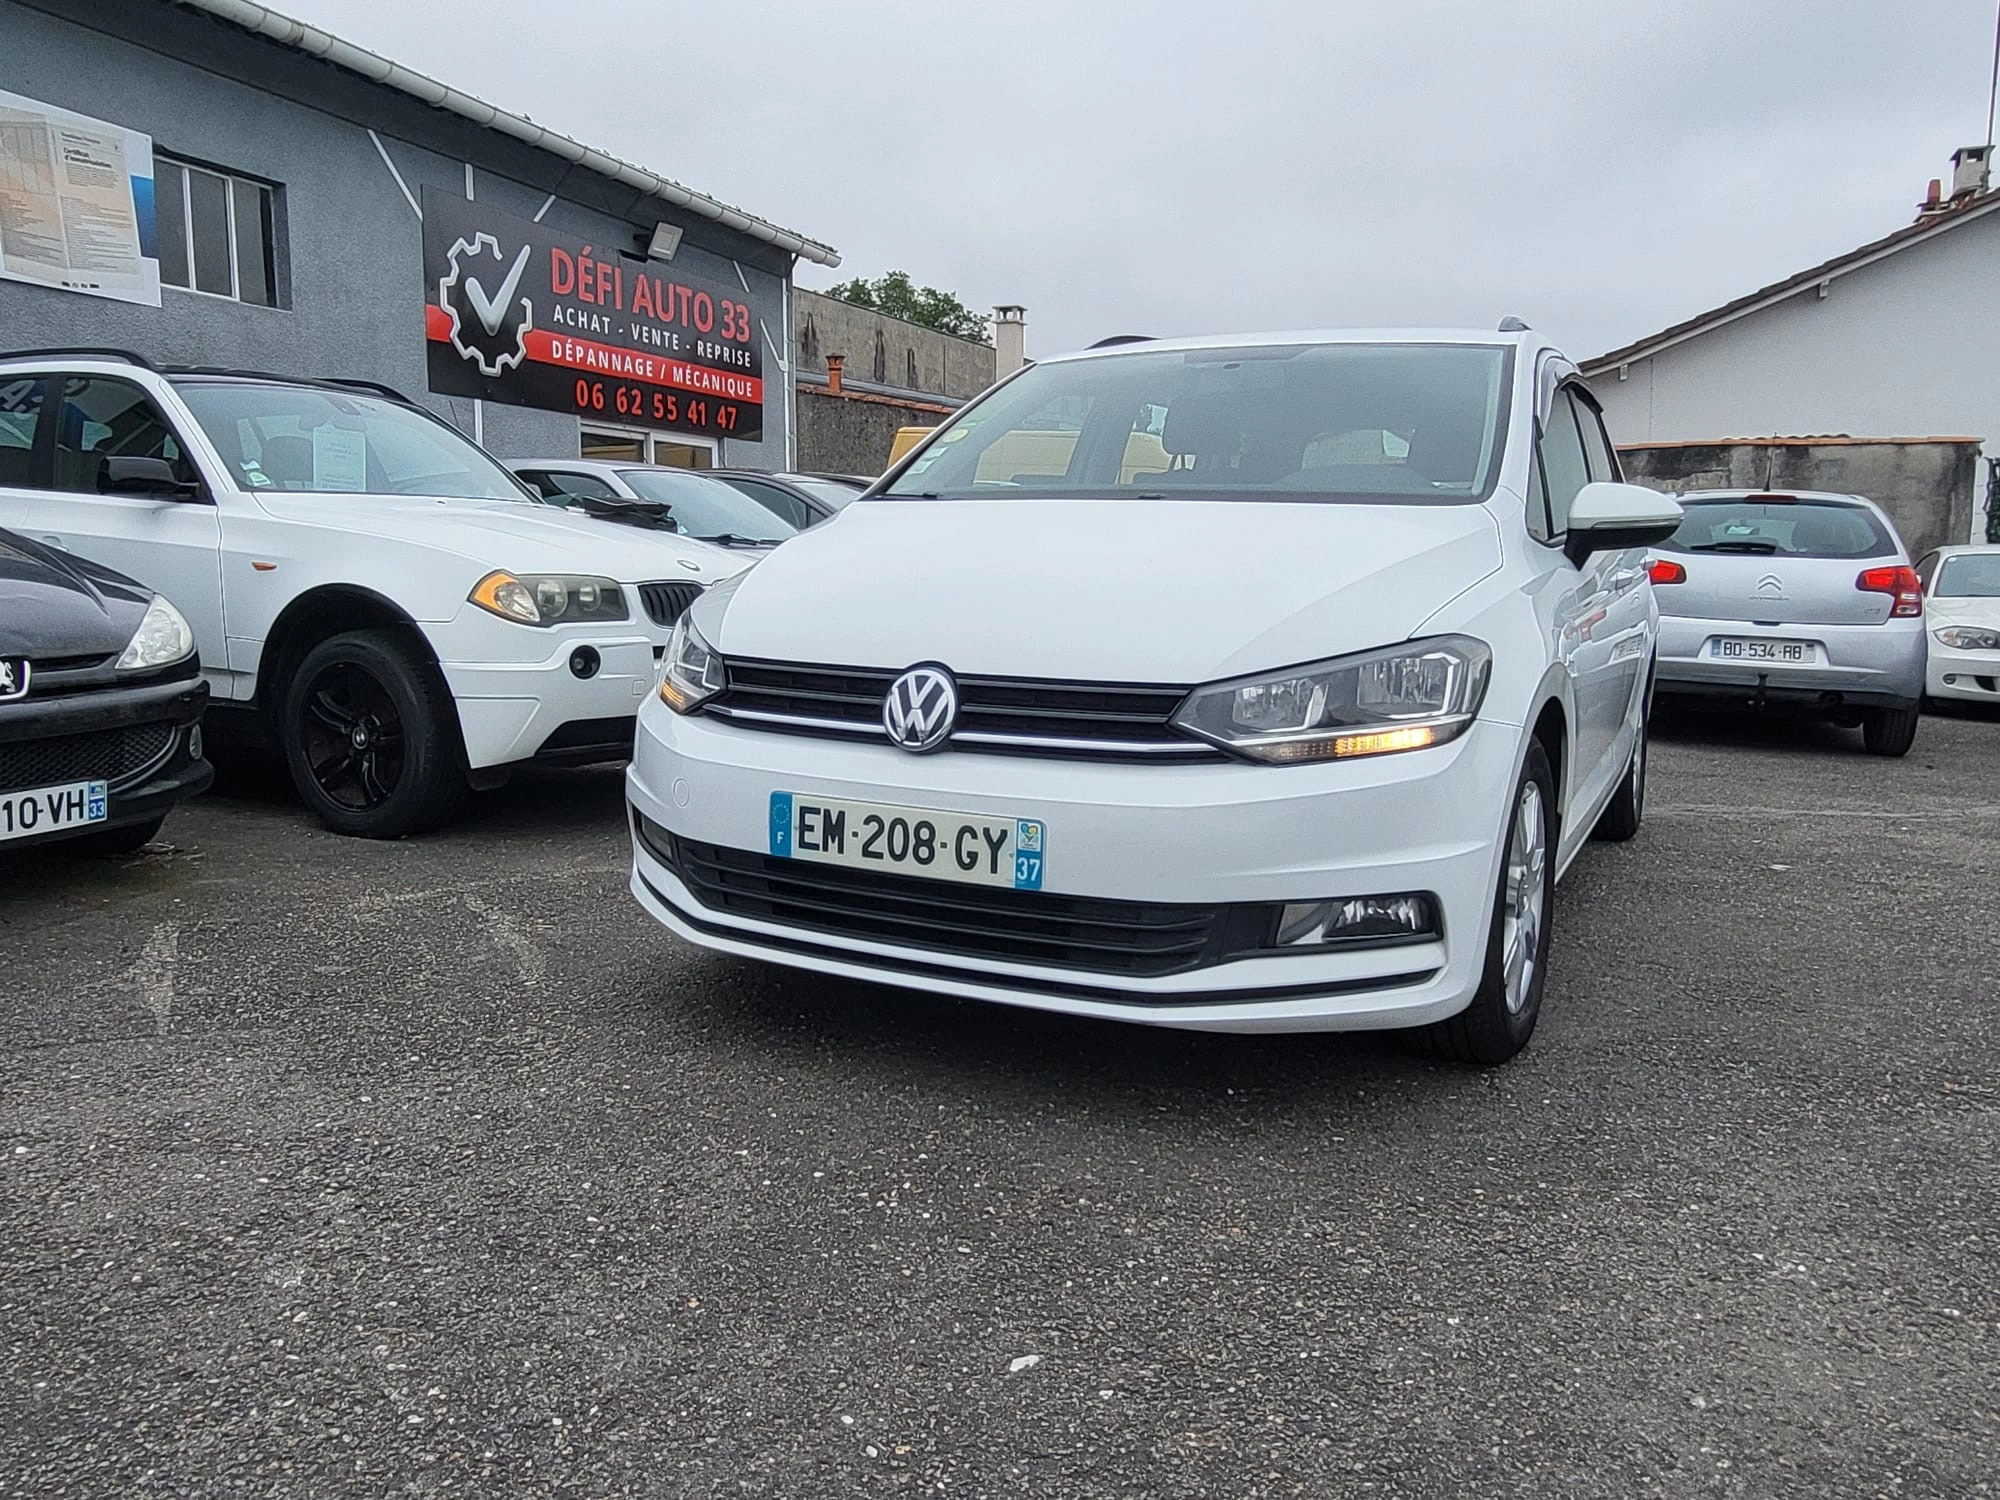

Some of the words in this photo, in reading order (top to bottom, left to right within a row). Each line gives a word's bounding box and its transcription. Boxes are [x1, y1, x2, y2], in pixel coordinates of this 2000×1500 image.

[551, 245, 622, 310] DÉFI
[632, 273, 714, 333] AUTO
[721, 299, 750, 342] 33
[553, 303, 611, 335] ACHAT
[631, 322, 679, 351] VENTE
[697, 340, 751, 367] REPRISE
[552, 338, 653, 377] DÉPANNAGE
[673, 364, 753, 398] MÉCANIQUE
[576, 379, 605, 410] 06
[616, 386, 642, 416] 62
[653, 393, 679, 421] 55
[688, 400, 707, 427] 41
[717, 405, 737, 430] 47
[89, 801, 105, 818] 33
[777, 831, 785, 844] F
[798, 805, 1008, 875] EM-208-GY
[1017, 856, 1041, 881] 37
